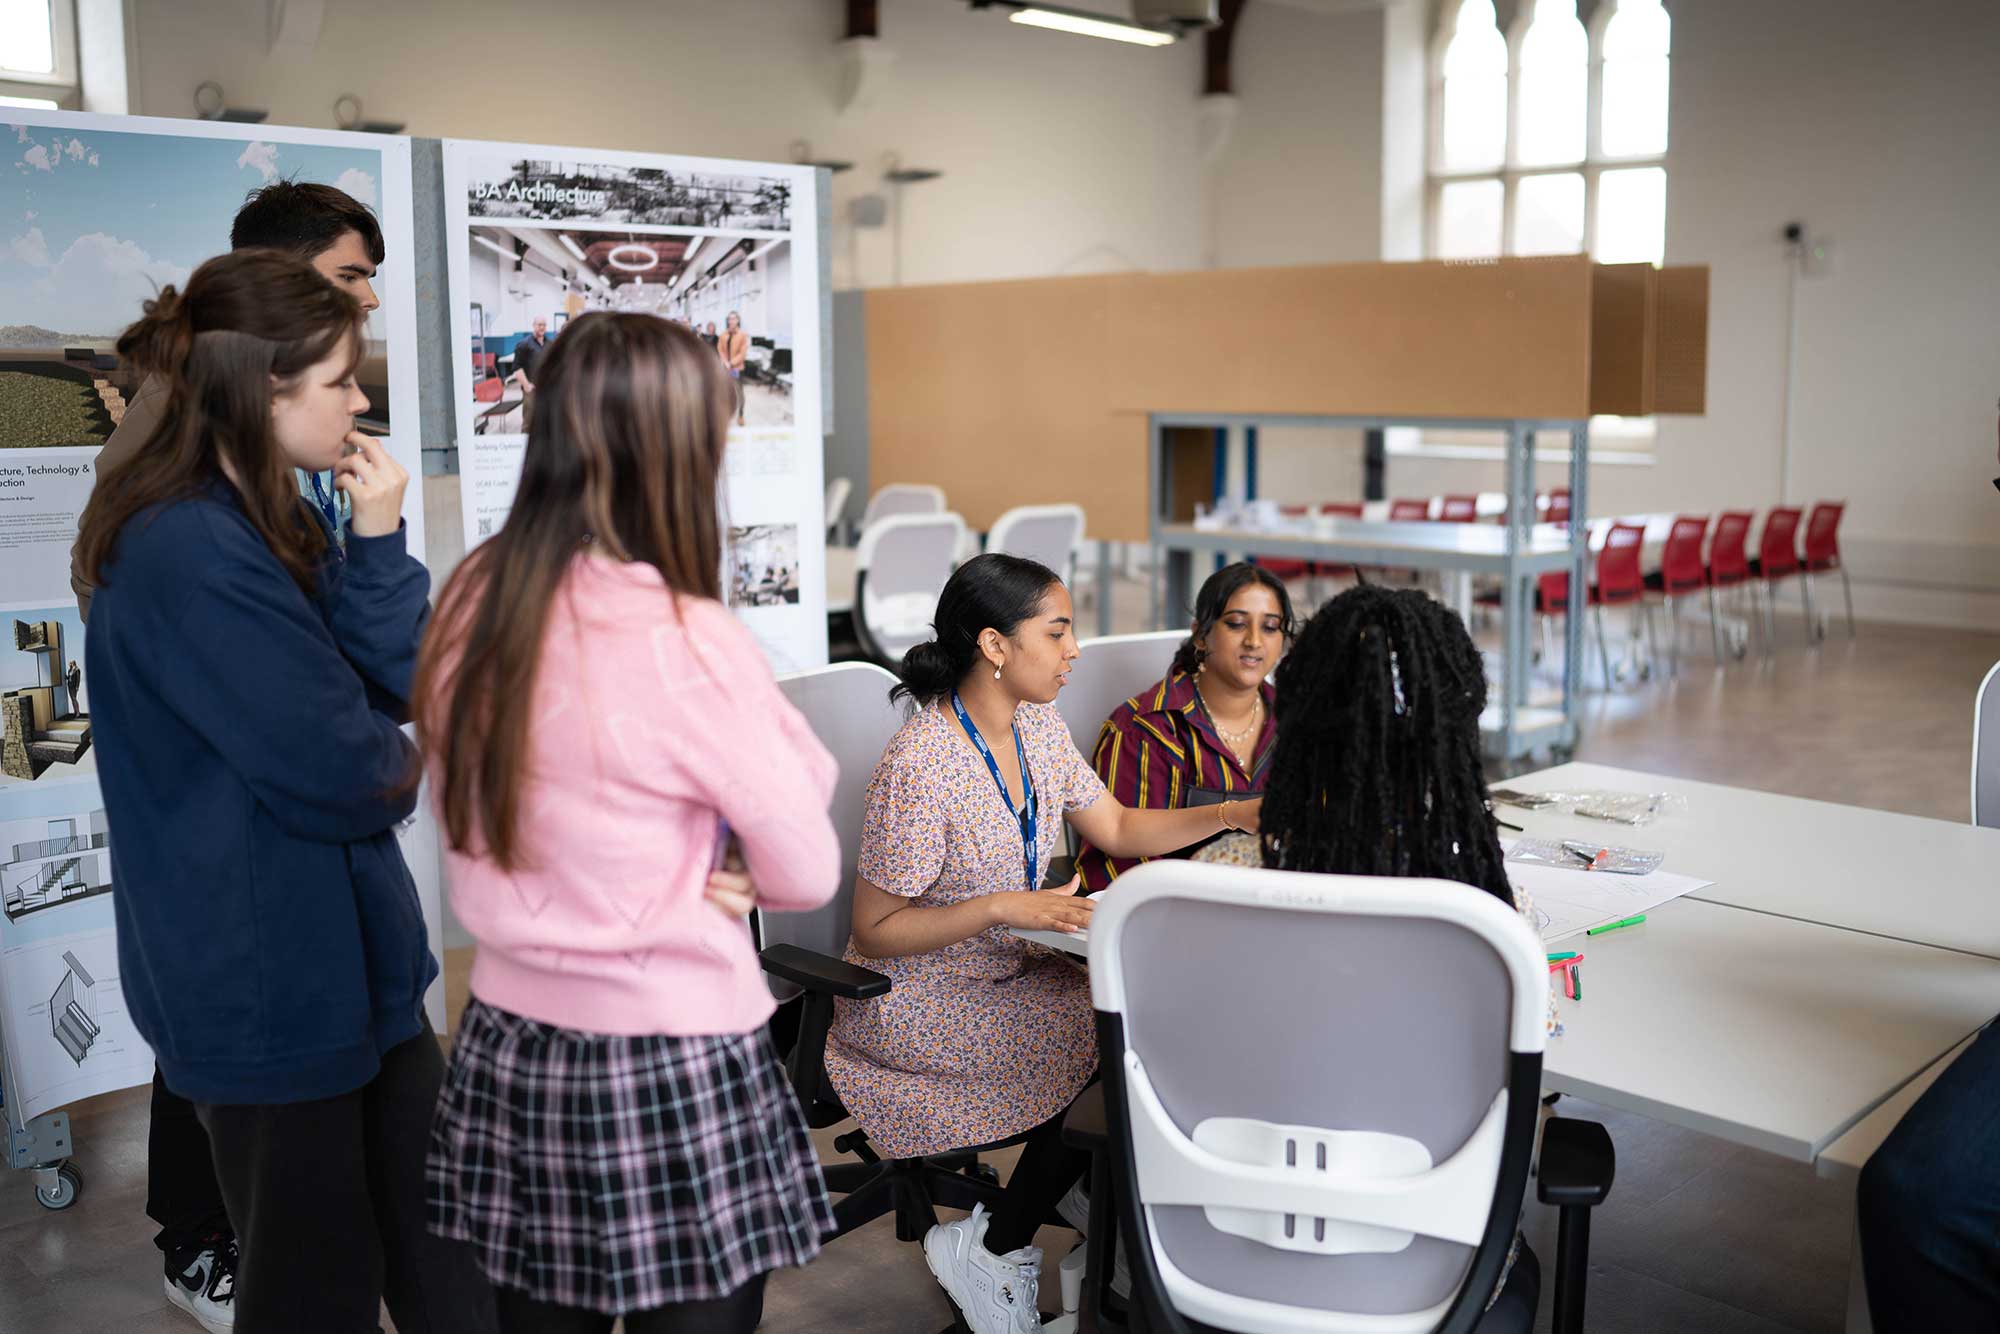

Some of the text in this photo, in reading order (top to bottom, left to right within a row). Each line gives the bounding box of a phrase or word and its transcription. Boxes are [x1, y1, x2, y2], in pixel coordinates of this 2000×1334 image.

[476, 180, 606, 203] BA Architecture
[26, 464, 80, 476] Technology
[82, 464, 90, 473] &
[1002, 1286, 1015, 1304] FILA
